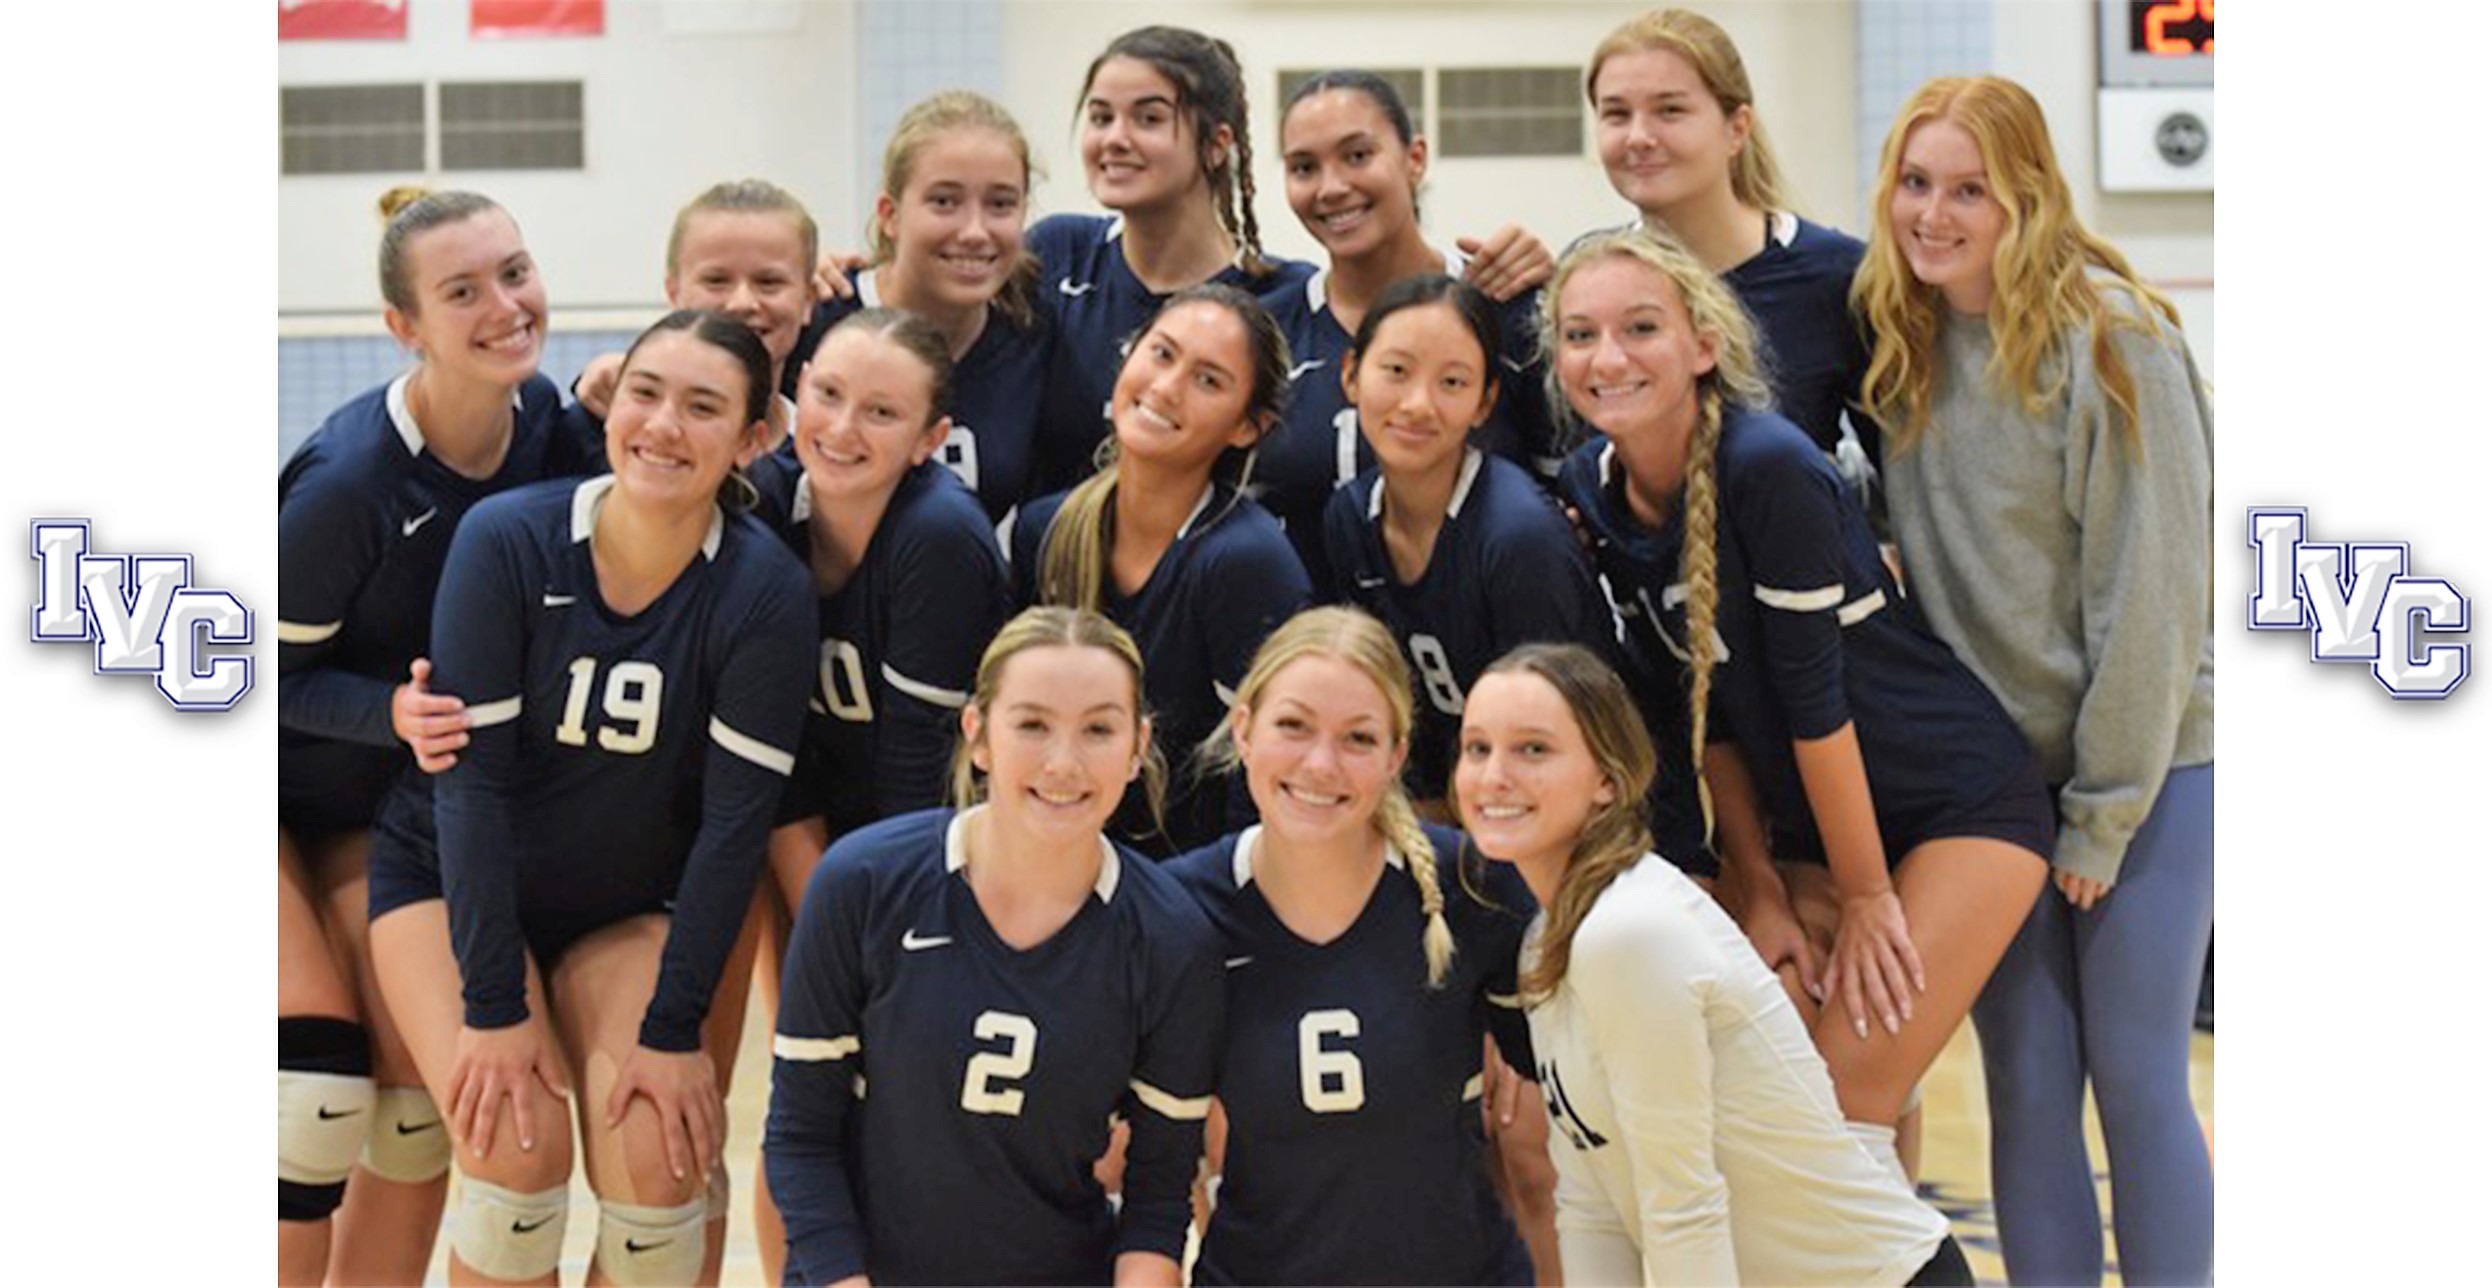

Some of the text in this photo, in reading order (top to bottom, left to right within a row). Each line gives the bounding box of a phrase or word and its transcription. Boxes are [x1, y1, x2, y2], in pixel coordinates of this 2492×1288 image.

[2143, 0, 2214, 58] 2
[555, 656, 664, 754] 19
[809, 637, 874, 722] 0
[1409, 633, 1464, 716] 8
[960, 1010, 1038, 1116] 2
[1299, 1008, 1365, 1113] 6
